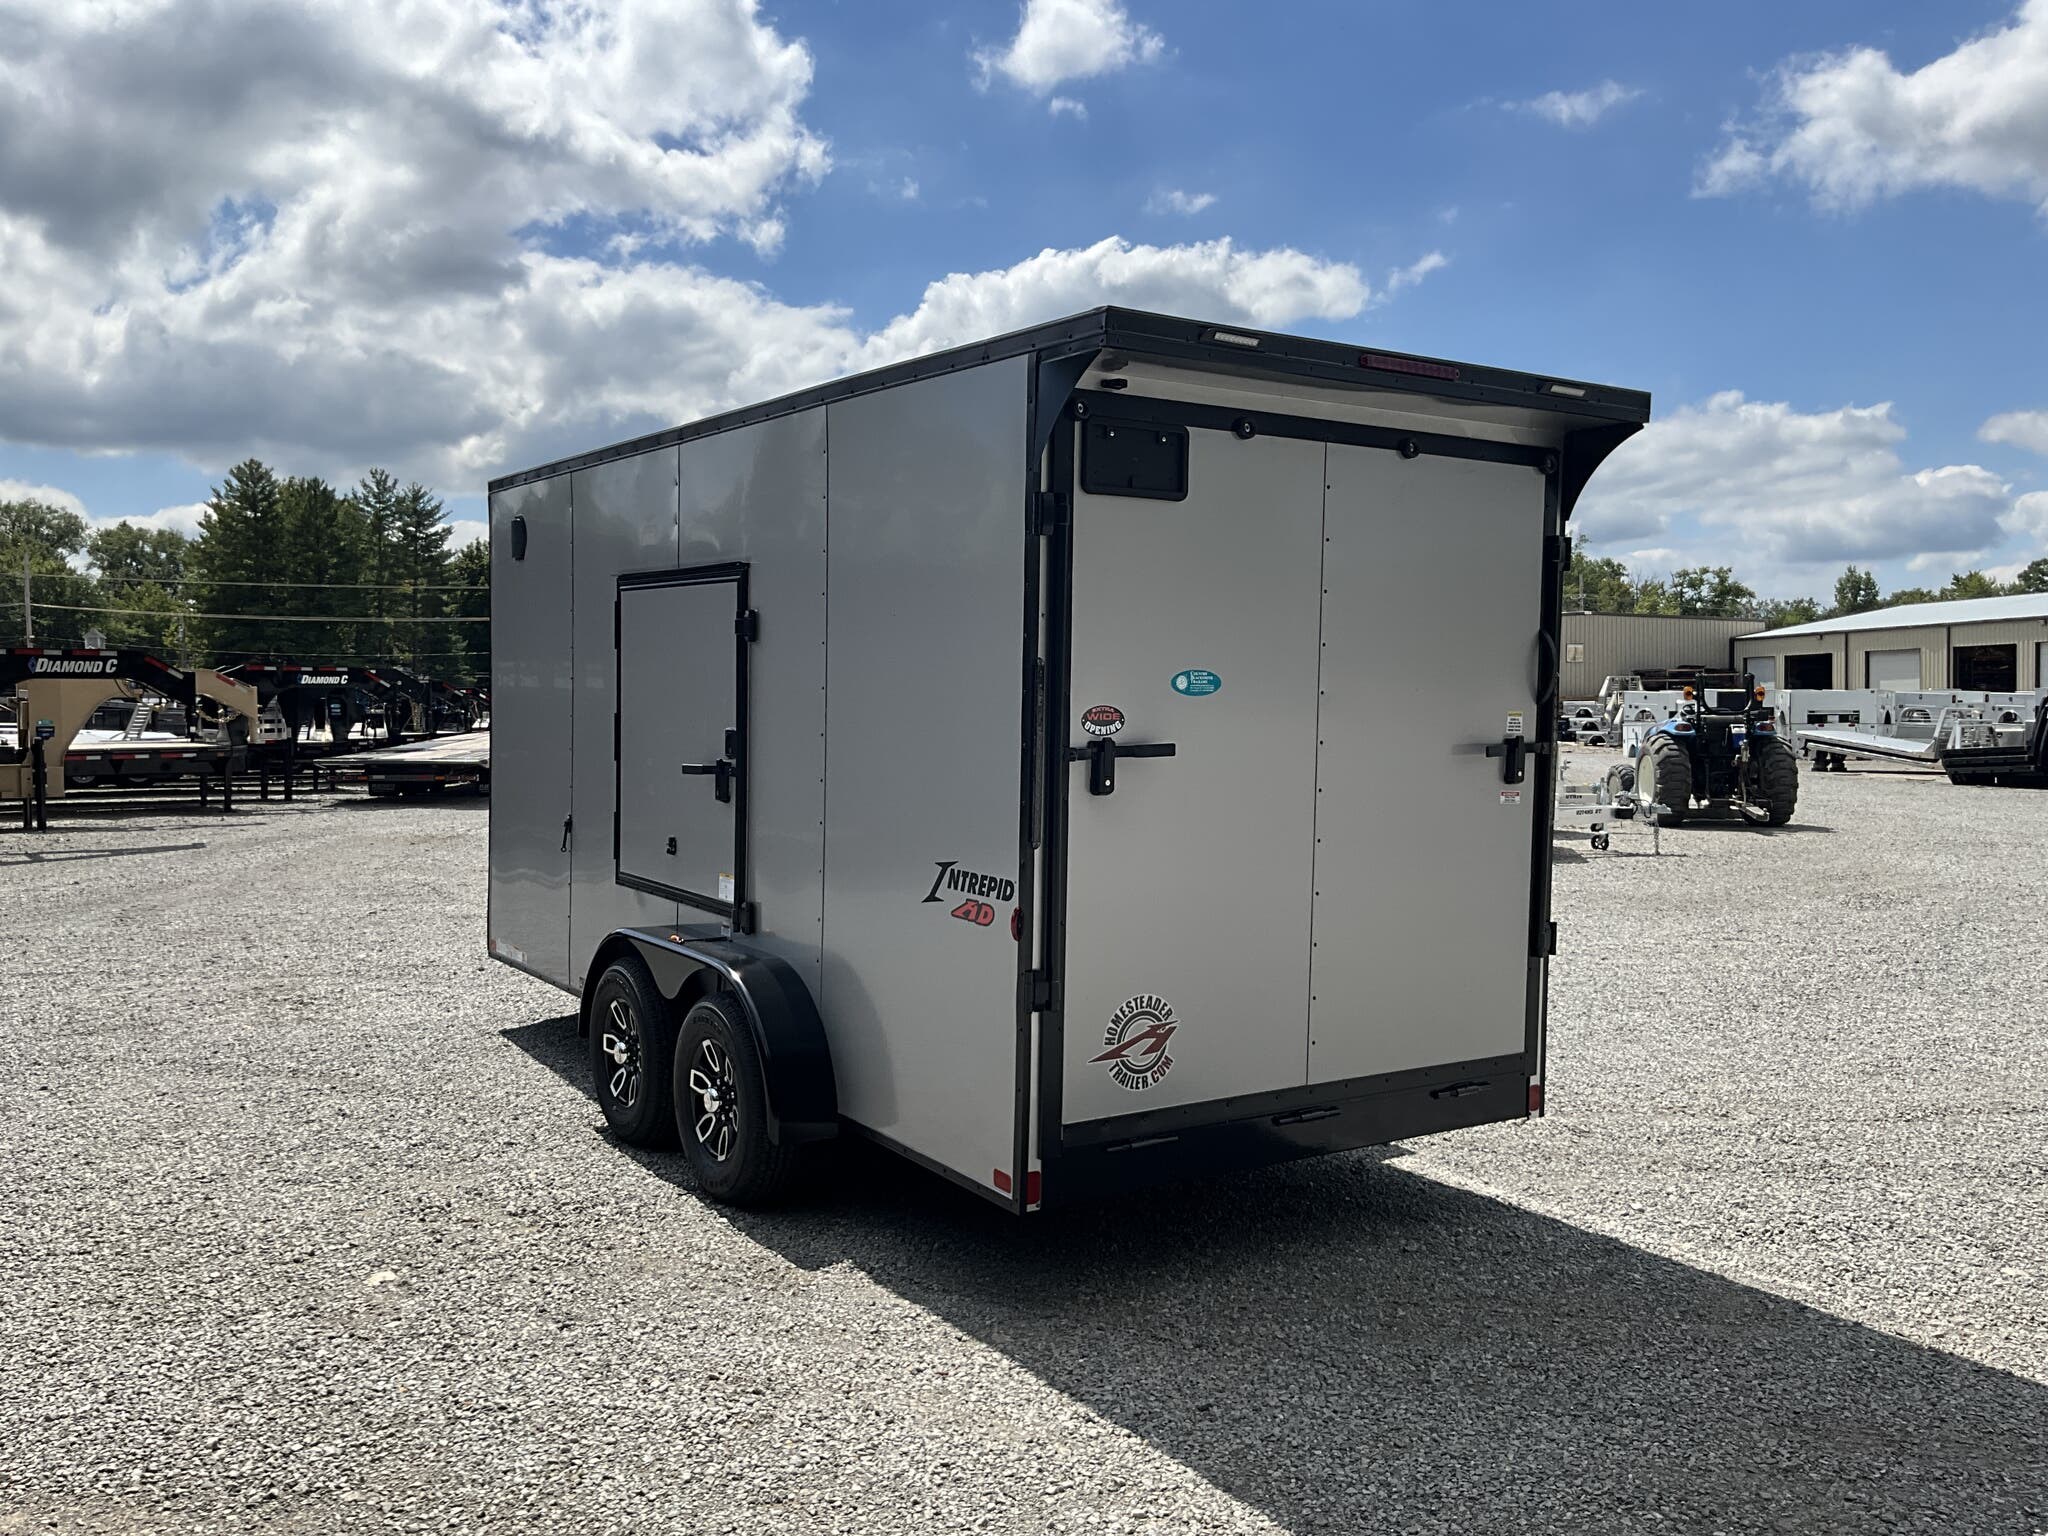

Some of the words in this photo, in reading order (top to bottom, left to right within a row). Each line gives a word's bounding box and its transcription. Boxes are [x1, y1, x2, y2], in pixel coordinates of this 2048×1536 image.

[35, 657, 103, 673] DIAMOND
[105, 658, 117, 673] C
[301, 674, 340, 685] DIAMOND
[340, 674, 349, 685] C
[1087, 713, 1121, 721] WIDE
[1084, 720, 1122, 735] OPENING
[921, 860, 1015, 903] INTREPID
[1104, 995, 1174, 1046] HOMESTEADER
[1108, 1055, 1174, 1090] TRAILER.COM
